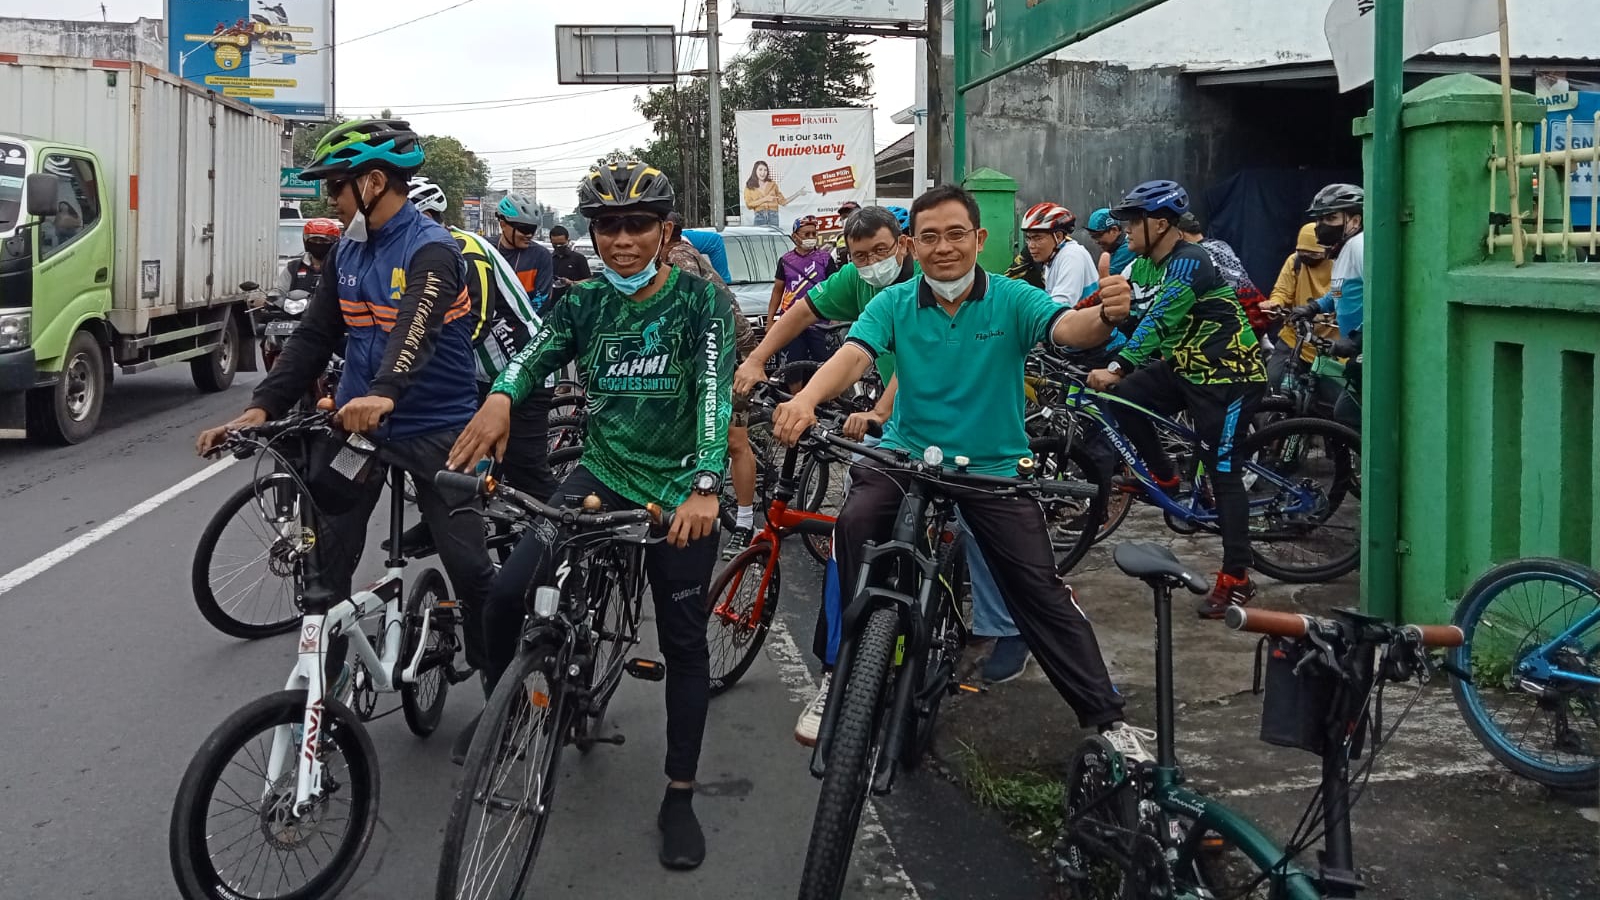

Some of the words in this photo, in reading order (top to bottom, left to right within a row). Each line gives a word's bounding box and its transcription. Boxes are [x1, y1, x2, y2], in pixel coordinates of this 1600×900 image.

[802, 116, 838, 125] PRAMITA
[779, 134, 785, 142] It
[787, 134, 794, 142] is
[795, 133, 811, 141] Our
[813, 133, 832, 141] 34th
[1554, 136, 1593, 150] SGN
[767, 143, 846, 160] Anniversary
[605, 353, 670, 377] KAHMI
[1102, 427, 1137, 466] FINGARD
